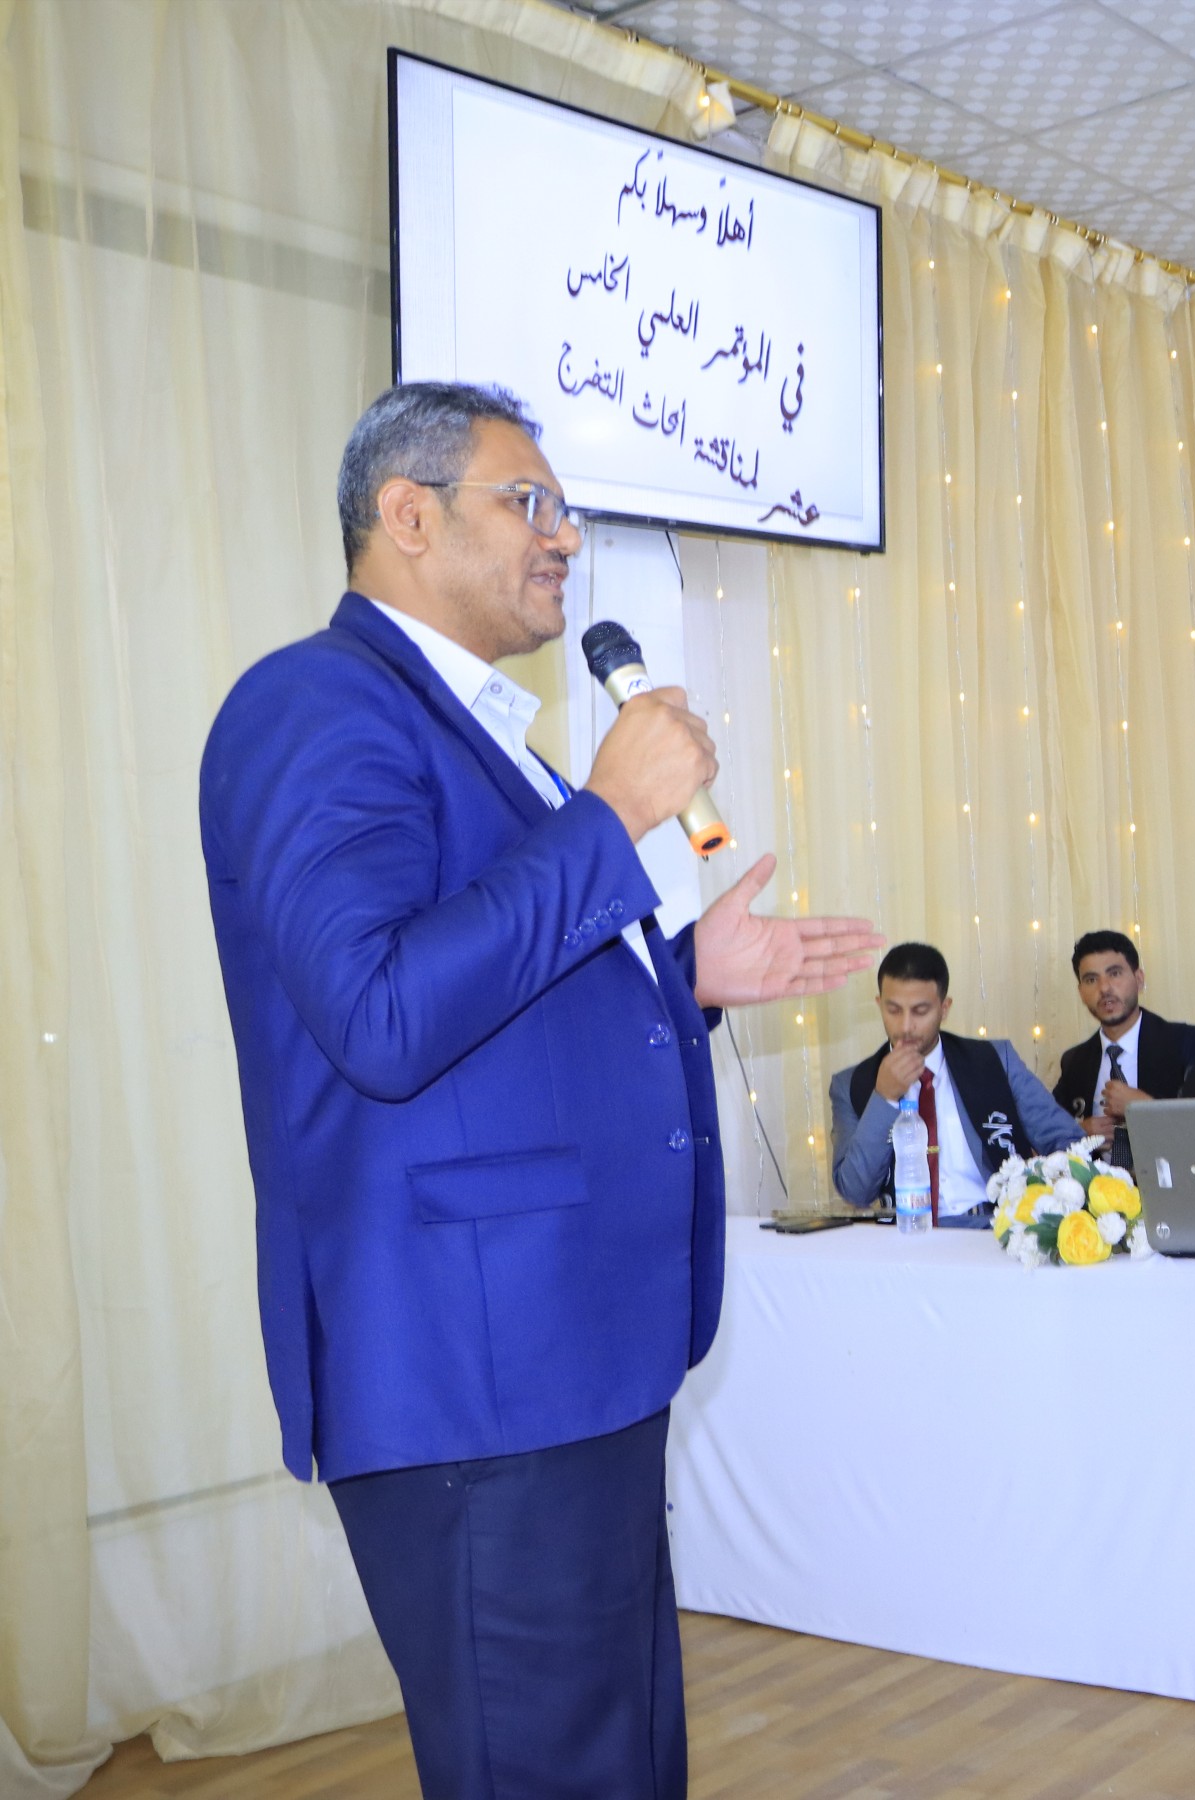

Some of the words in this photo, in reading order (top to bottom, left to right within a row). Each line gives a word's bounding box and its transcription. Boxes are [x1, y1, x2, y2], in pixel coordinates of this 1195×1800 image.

[617, 149, 649, 225] بكم
[567, 253, 630, 300] الخامس
[638, 290, 699, 357] العلمي
[558, 341, 624, 404] التخرج
[701, 326, 770, 383] المؤتمر
[780, 342, 805, 432] في
[693, 438, 760, 489] لمناقشة
[758, 489, 820, 525] عشر
